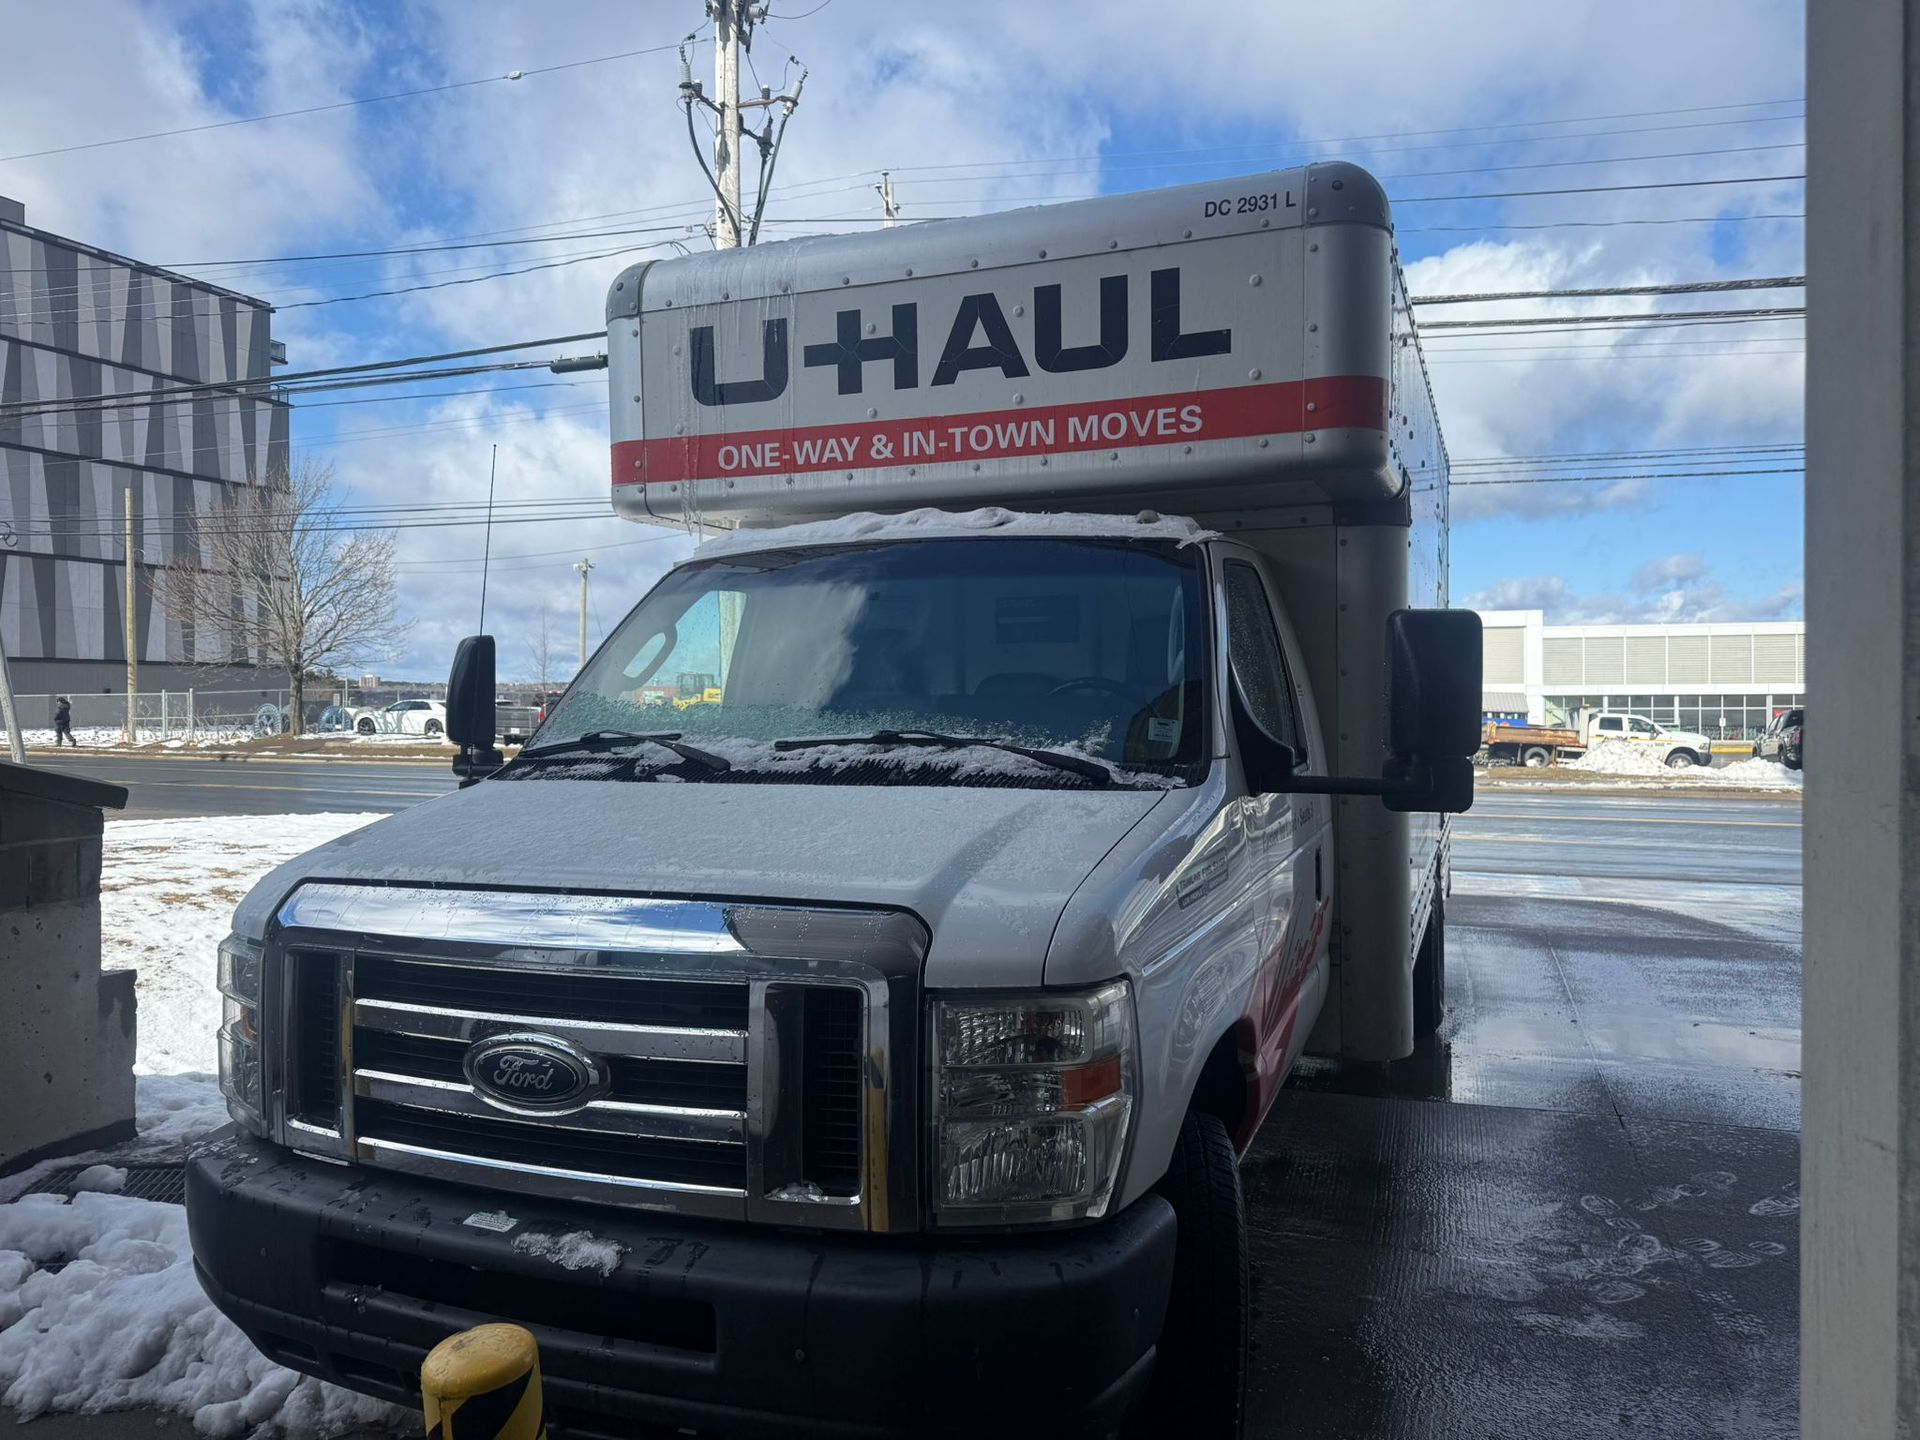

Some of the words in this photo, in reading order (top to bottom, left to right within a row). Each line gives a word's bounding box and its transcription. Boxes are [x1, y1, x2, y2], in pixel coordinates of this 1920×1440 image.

[1204, 199, 1232, 218] DC
[1237, 192, 1278, 214] 2931
[1285, 191, 1297, 208] L
[689, 267, 1232, 406] U-HAUL
[717, 436, 861, 471] ONE-WAY
[870, 434, 895, 460] &
[903, 419, 1055, 457] IN-TOWN
[1067, 404, 1203, 444] MOVES
[494, 1055, 554, 1090] Ford
